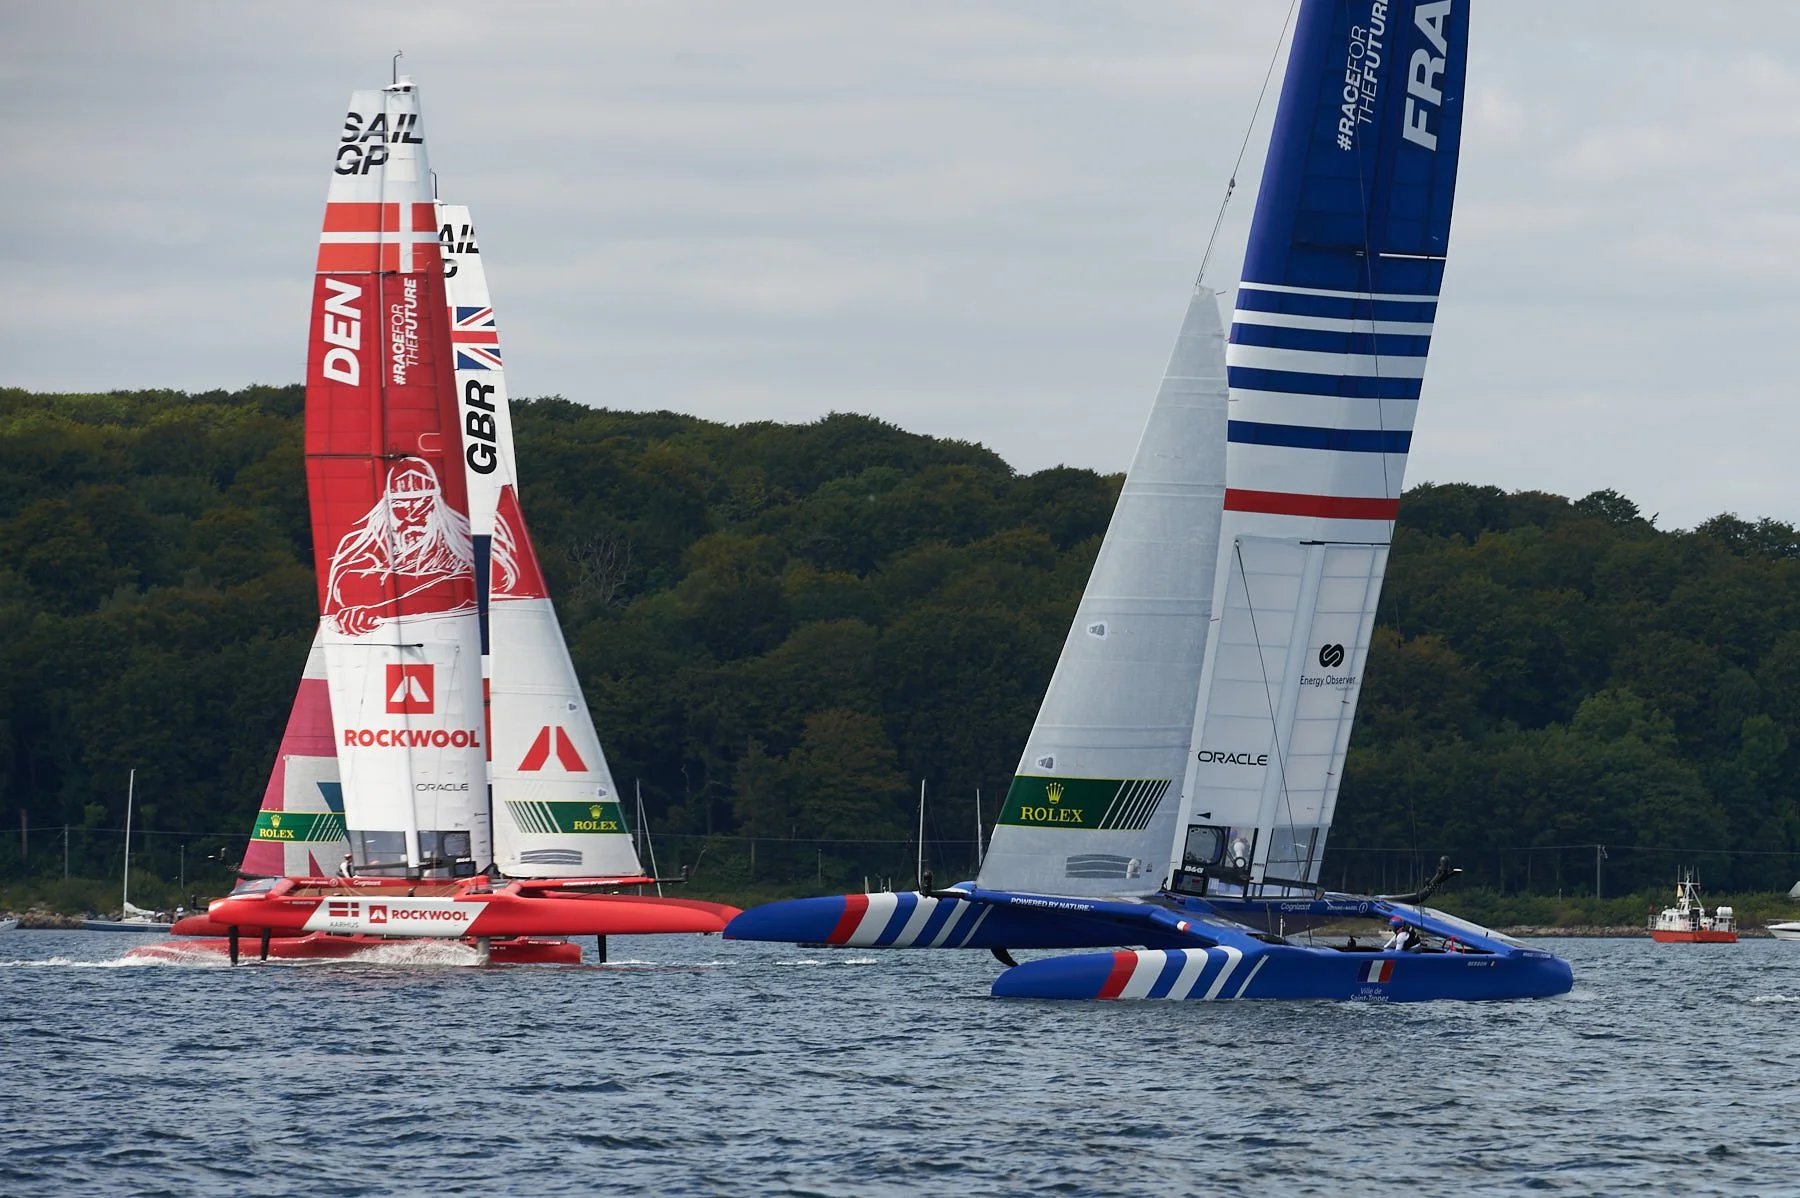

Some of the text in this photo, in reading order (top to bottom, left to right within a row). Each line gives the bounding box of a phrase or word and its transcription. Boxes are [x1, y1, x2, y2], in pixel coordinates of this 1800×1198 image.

[1357, 0, 1388, 124] THEFUTUR
[1337, 25, 1367, 151] #RACEFOR
[1402, 0, 1452, 152] FRA
[341, 111, 424, 144] SAIL
[334, 144, 390, 175] GP
[438, 223, 480, 254] AIL
[323, 278, 363, 387] DEN
[405, 277, 417, 366] THEFUTURE
[393, 303, 406, 386] #RACEFOR
[465, 378, 496, 475] GBR
[1300, 674, 1356, 687] Energy Observer
[344, 729, 480, 748] ROCKWOOL
[1197, 750, 1268, 767] ORACLE
[416, 783, 469, 792] ORACLE
[573, 821, 618, 830] ROLEX
[1020, 805, 1084, 823] ROLEX
[259, 828, 294, 839] ROLEX
[1010, 897, 1048, 907] POWERED
[391, 909, 470, 921] ROCKWOOL
[1374, 987, 1382, 995] de
